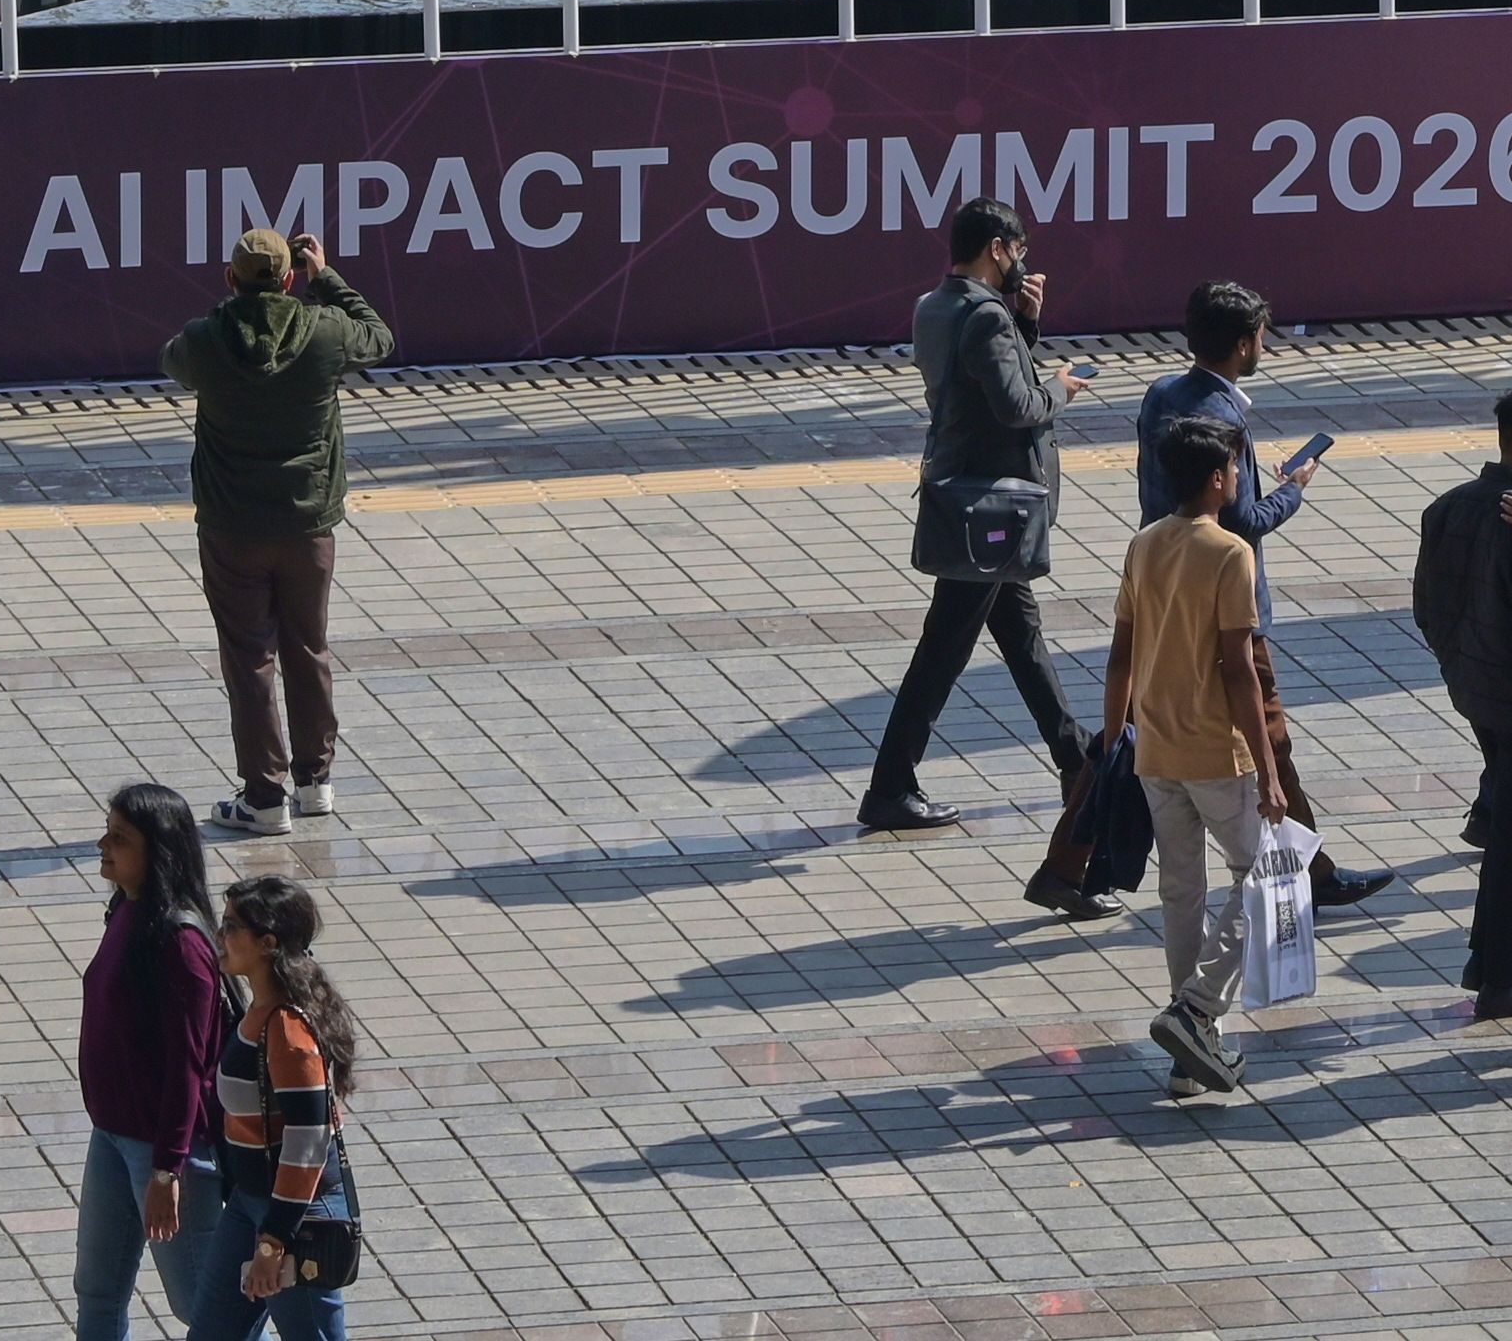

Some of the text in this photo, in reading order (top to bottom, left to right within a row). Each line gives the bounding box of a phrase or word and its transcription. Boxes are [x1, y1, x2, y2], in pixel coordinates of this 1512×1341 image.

[19, 171, 143, 274] AI
[186, 146, 669, 266] IMPACT
[708, 121, 1217, 240] SUMMIT
